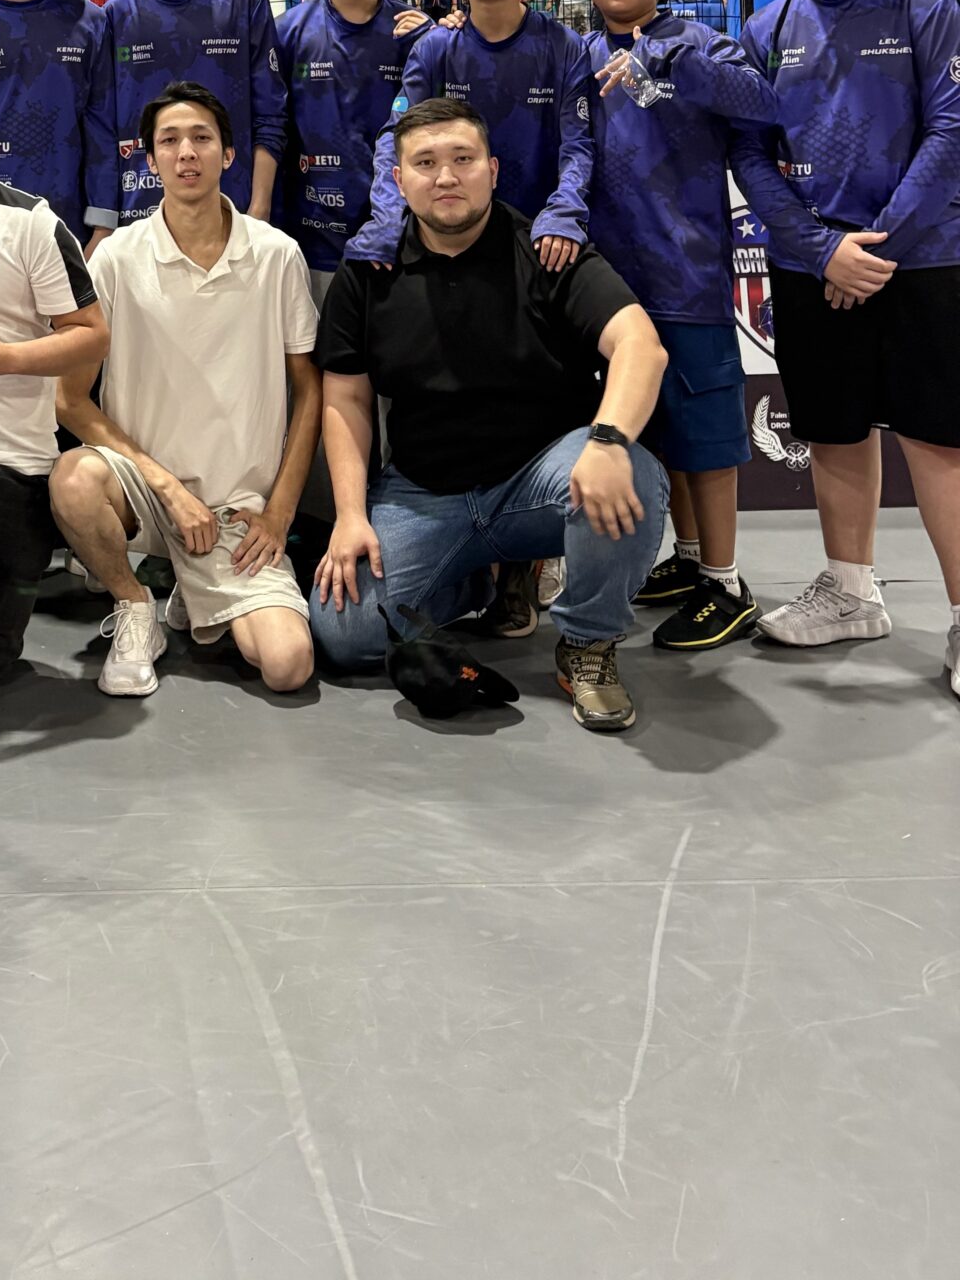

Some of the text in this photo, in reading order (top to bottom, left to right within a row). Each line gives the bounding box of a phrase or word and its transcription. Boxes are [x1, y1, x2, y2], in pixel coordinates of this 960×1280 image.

[132, 42, 154, 51] Kemel
[878, 38, 899, 46] LEV
[132, 51, 151, 60] Bilim
[310, 61, 334, 69] Kemel
[310, 70, 330, 78] Bilim
[445, 82, 471, 92] Kemel
[315, 155, 341, 166] IETU
[138, 175, 164, 190] KDS
[318, 194, 345, 207] KDS
